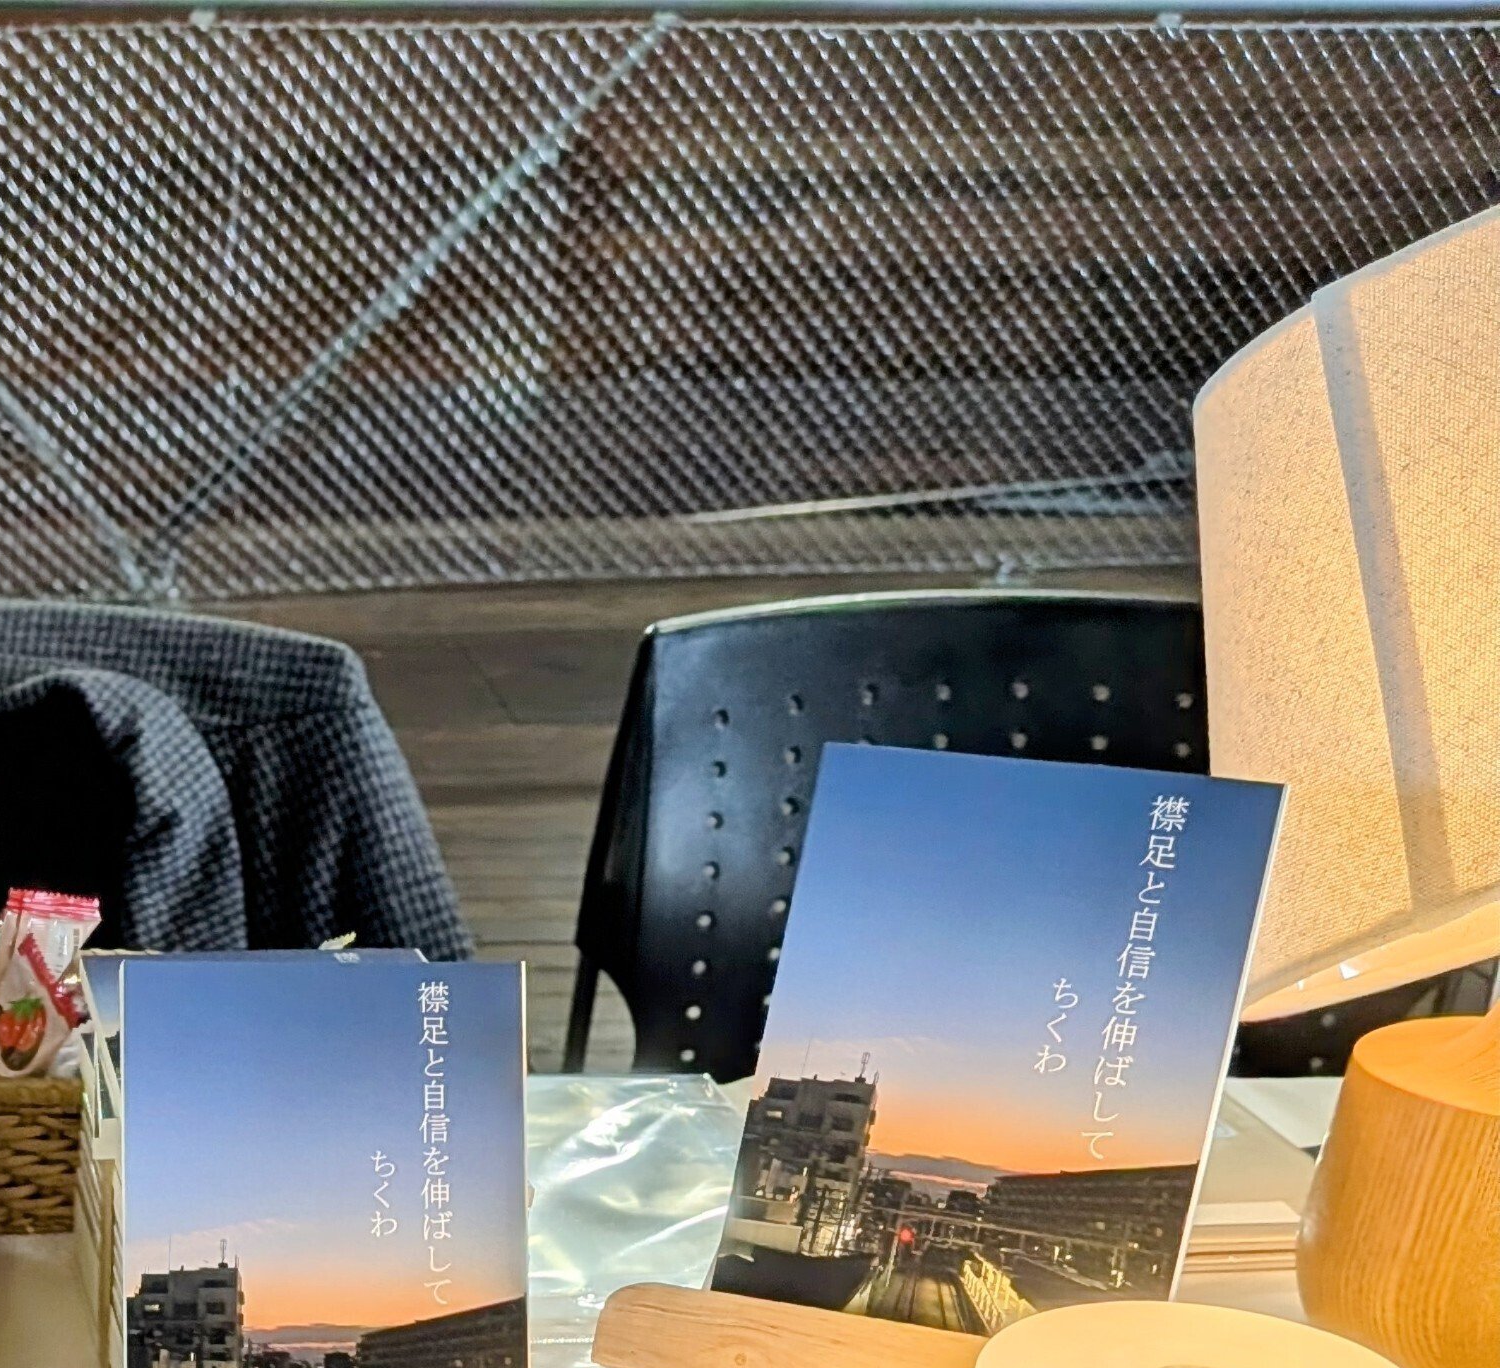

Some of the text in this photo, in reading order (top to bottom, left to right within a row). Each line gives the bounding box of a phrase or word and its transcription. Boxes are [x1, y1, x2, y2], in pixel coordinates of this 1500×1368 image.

[1032, 977, 1080, 1074] ちくわ
[1080, 795, 1191, 1161] 襟足と自信を伸ばして
[370, 1149, 398, 1238] ちくわ
[417, 981, 452, 1305] 襟足と自信を伸ばして
